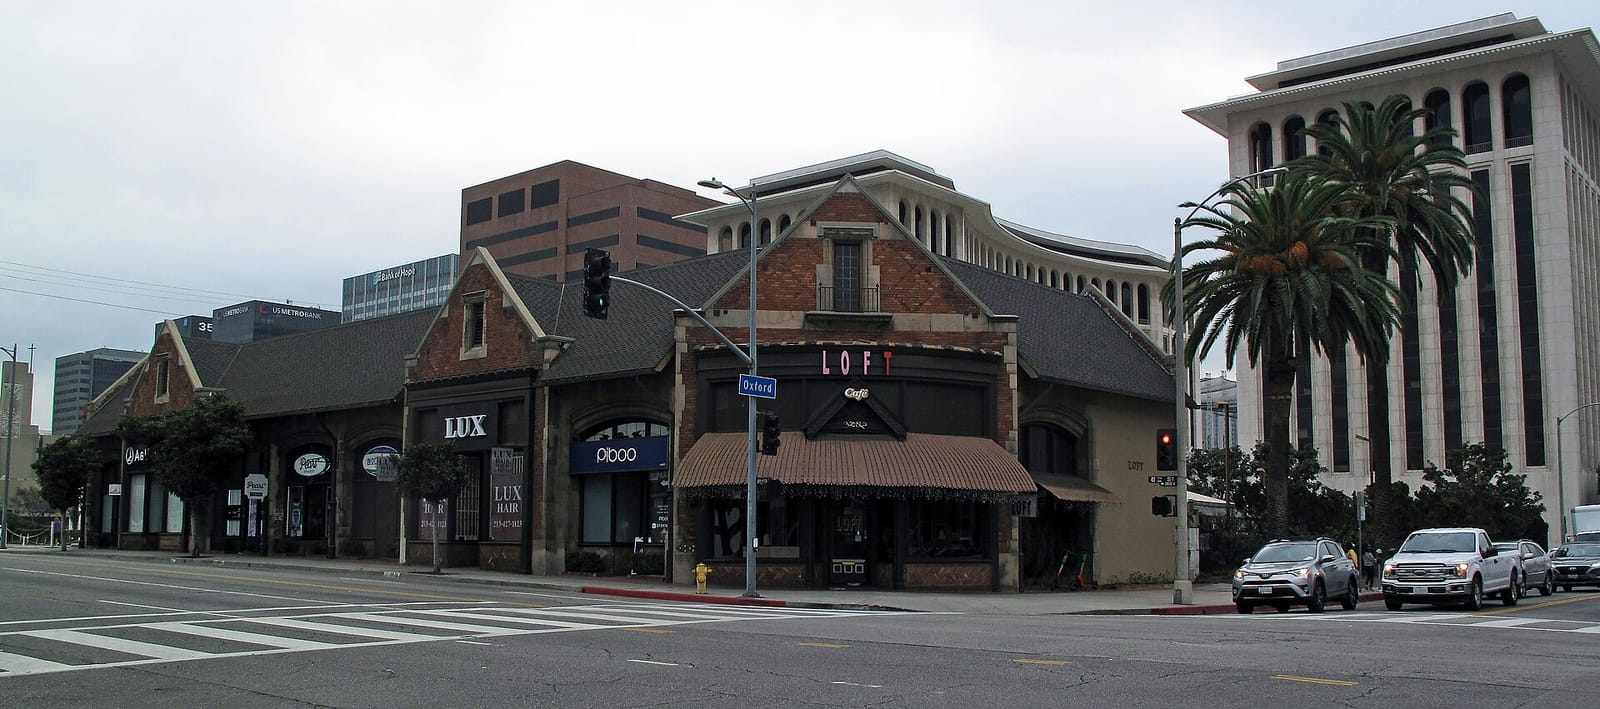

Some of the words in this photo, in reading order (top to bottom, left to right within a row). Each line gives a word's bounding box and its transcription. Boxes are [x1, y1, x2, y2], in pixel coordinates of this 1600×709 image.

[381, 272, 395, 281] Bank
[822, 350, 893, 376] LOFT
[743, 379, 772, 393] Oxford
[844, 387, 870, 401] Café
[444, 414, 487, 439] LUX
[596, 447, 637, 463] piboo
[494, 486, 522, 501] LUX
[424, 504, 445, 514] HR
[497, 503, 519, 514] HAIR
